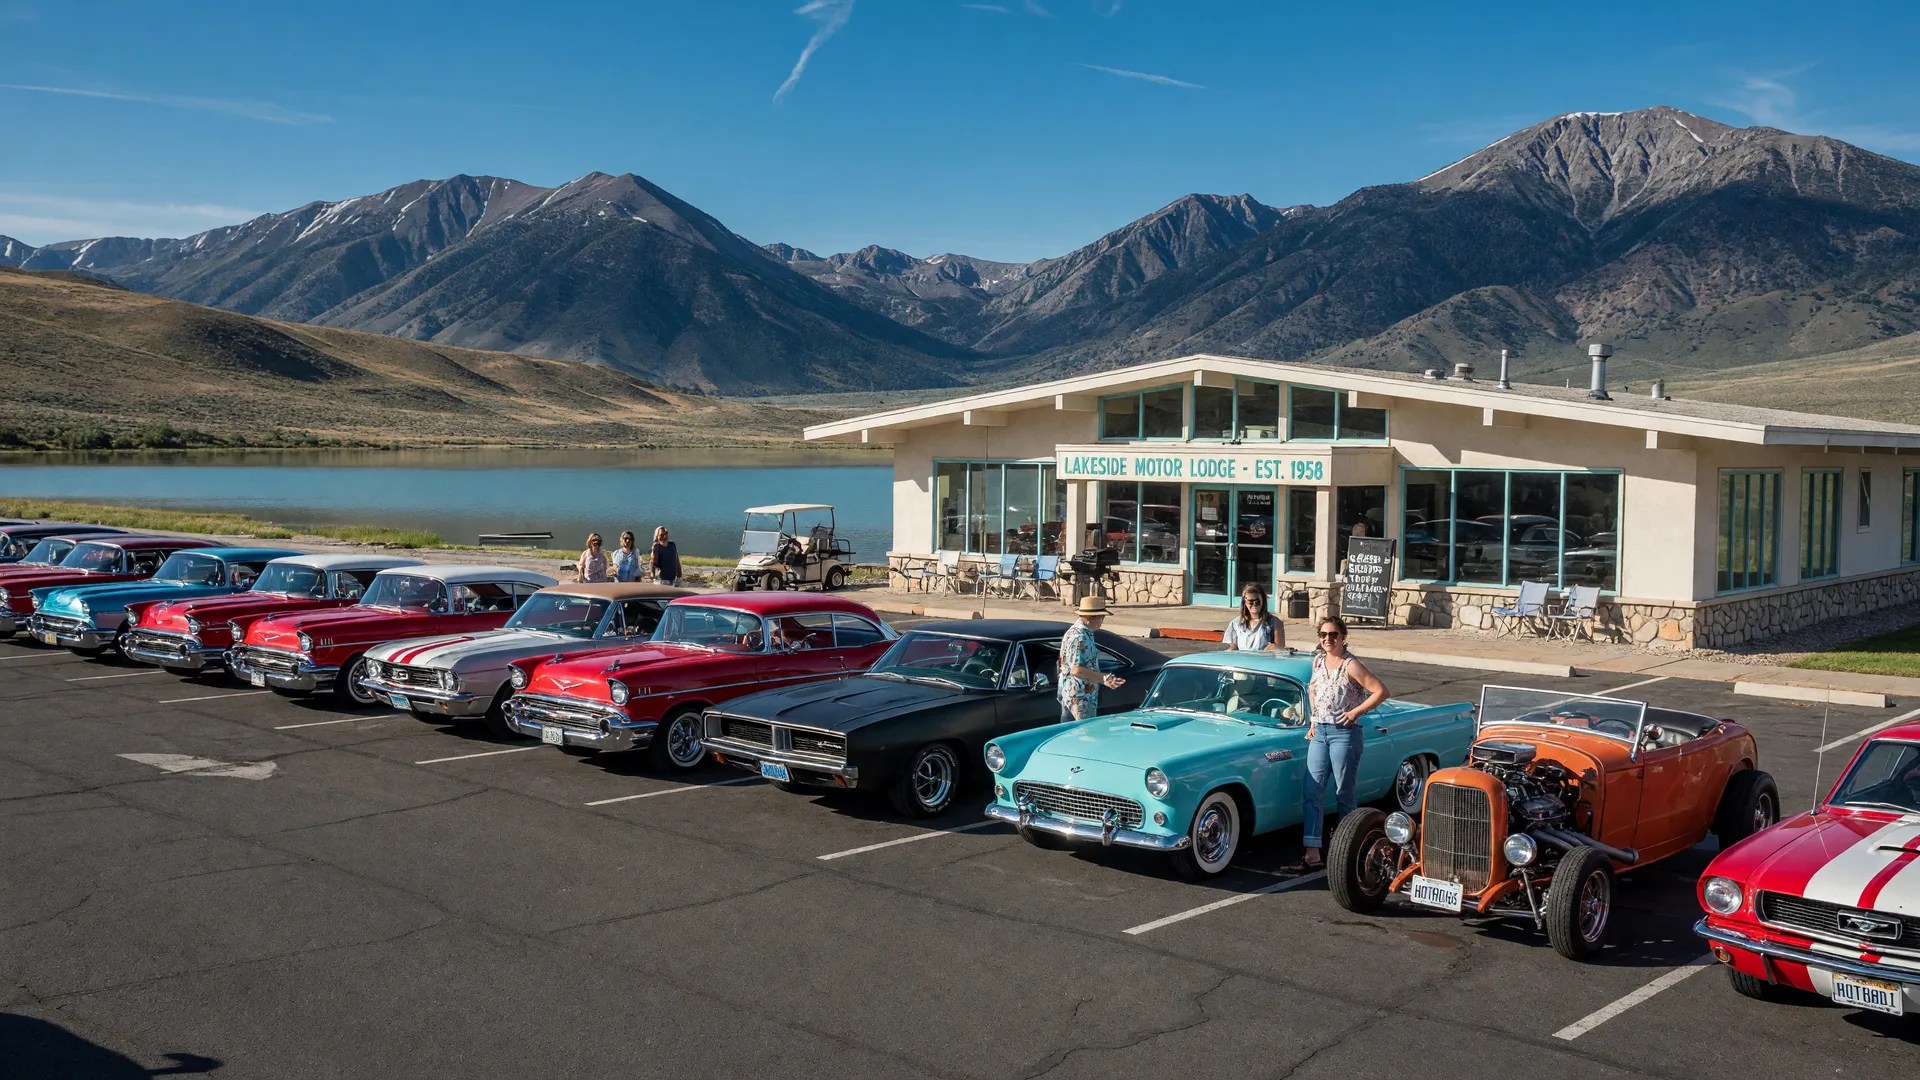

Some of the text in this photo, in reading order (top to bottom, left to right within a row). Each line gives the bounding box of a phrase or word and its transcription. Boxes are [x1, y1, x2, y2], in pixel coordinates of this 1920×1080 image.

[1064, 456, 1127, 476] LAKESIDE
[1135, 457, 1183, 477] MOTOR
[1190, 458, 1236, 479] LODGE
[1255, 459, 1285, 480] EST.
[1290, 460, 1324, 481] 1958
